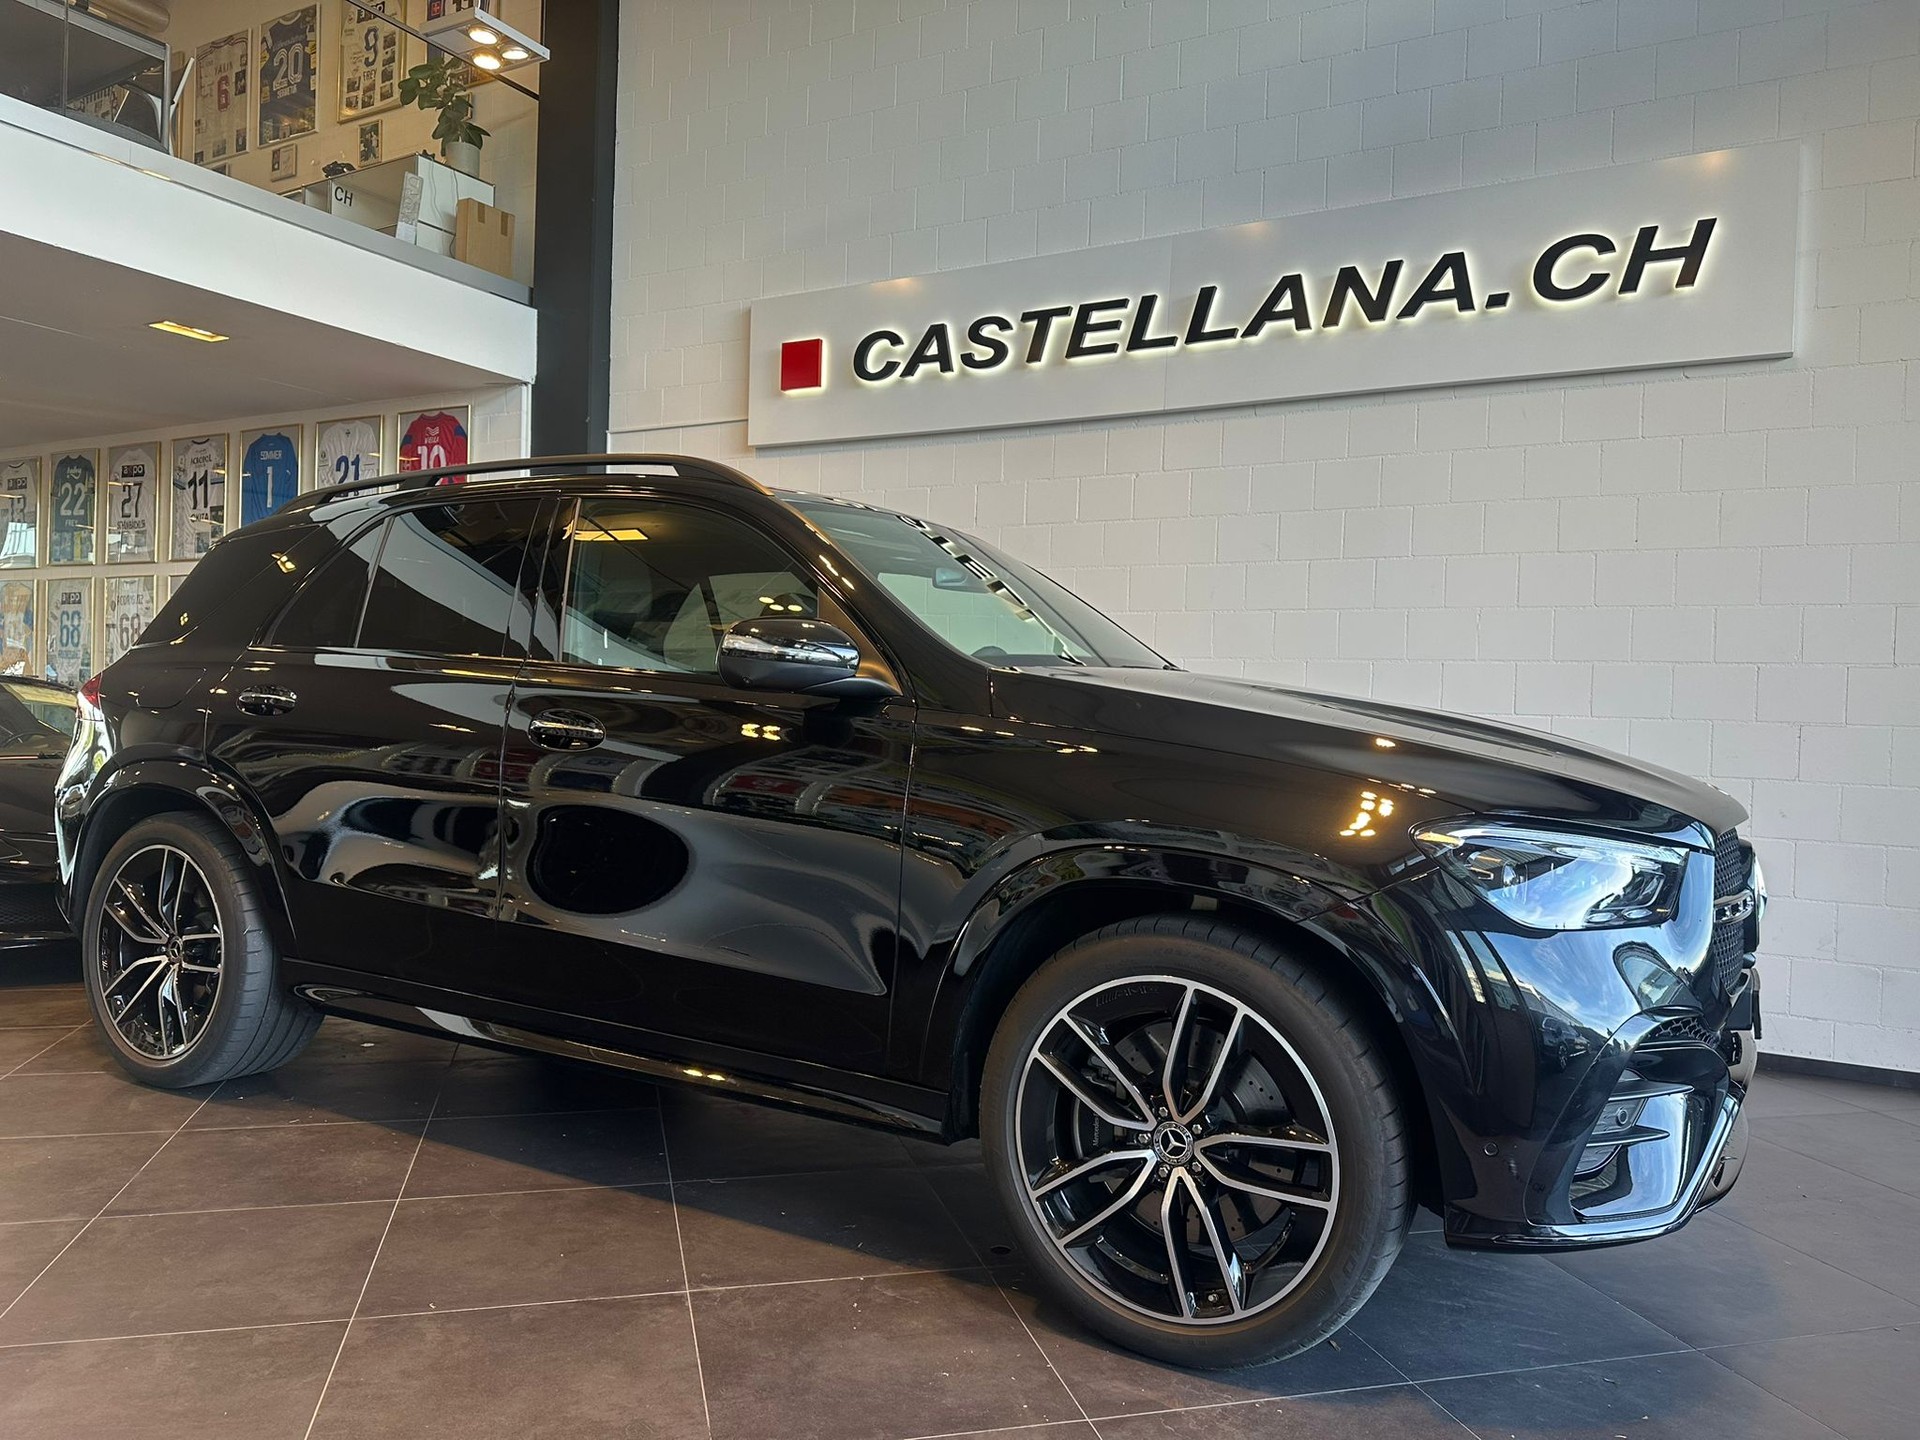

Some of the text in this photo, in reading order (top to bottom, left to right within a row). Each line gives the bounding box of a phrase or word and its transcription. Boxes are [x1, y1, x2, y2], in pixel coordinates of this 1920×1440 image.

[364, 26, 379, 67] 9
[273, 43, 303, 91] 20
[217, 75, 230, 112] 6
[334, 186, 353, 207] CH
[853, 217, 1717, 381] CASTELLANA.CH
[188, 469, 209, 510] 11
[266, 466, 273, 508] 1
[336, 454, 361, 496] 21
[60, 482, 86, 517] 22
[121, 481, 143, 518] 27
[59, 610, 81, 648] 68
[119, 613, 141, 650] 68
